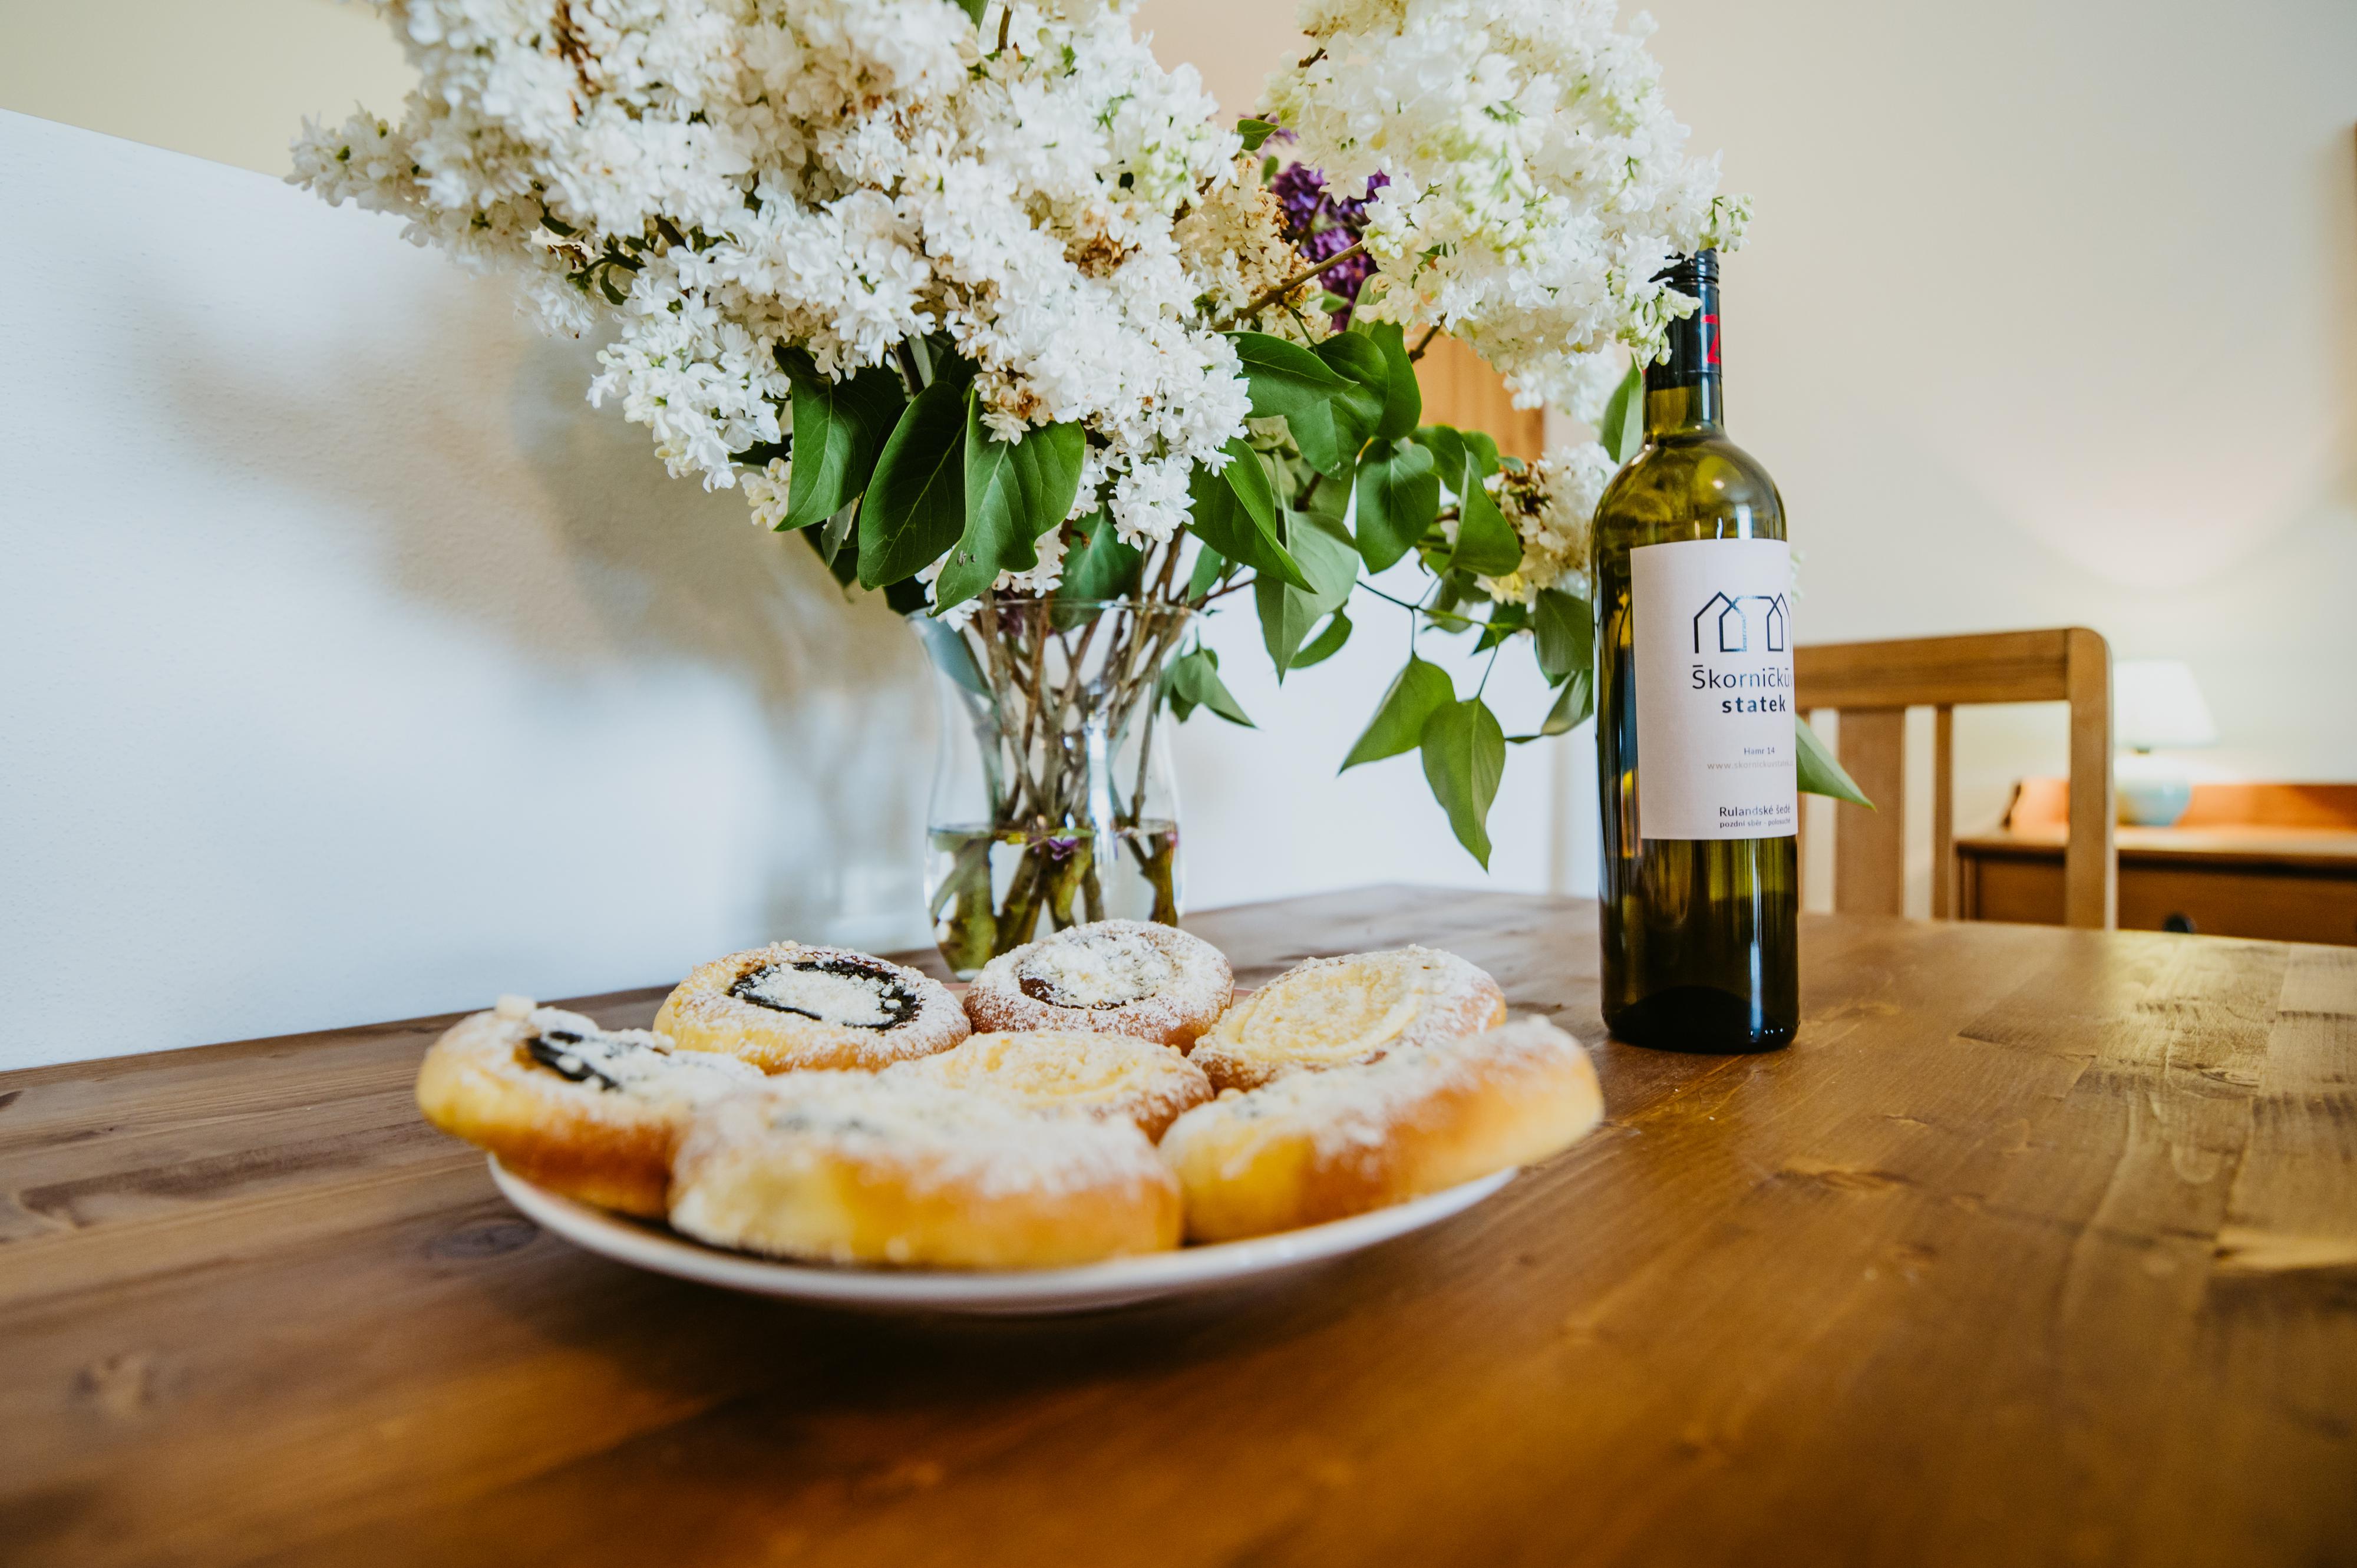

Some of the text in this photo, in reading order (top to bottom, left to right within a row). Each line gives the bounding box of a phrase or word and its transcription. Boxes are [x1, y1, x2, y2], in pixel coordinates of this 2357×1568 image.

[1722, 694, 1785, 713] statek
[1767, 747, 1775, 755] 14
[1719, 803, 1791, 817] Rulandské šedé
[1720, 820, 1745, 828] pozdní
